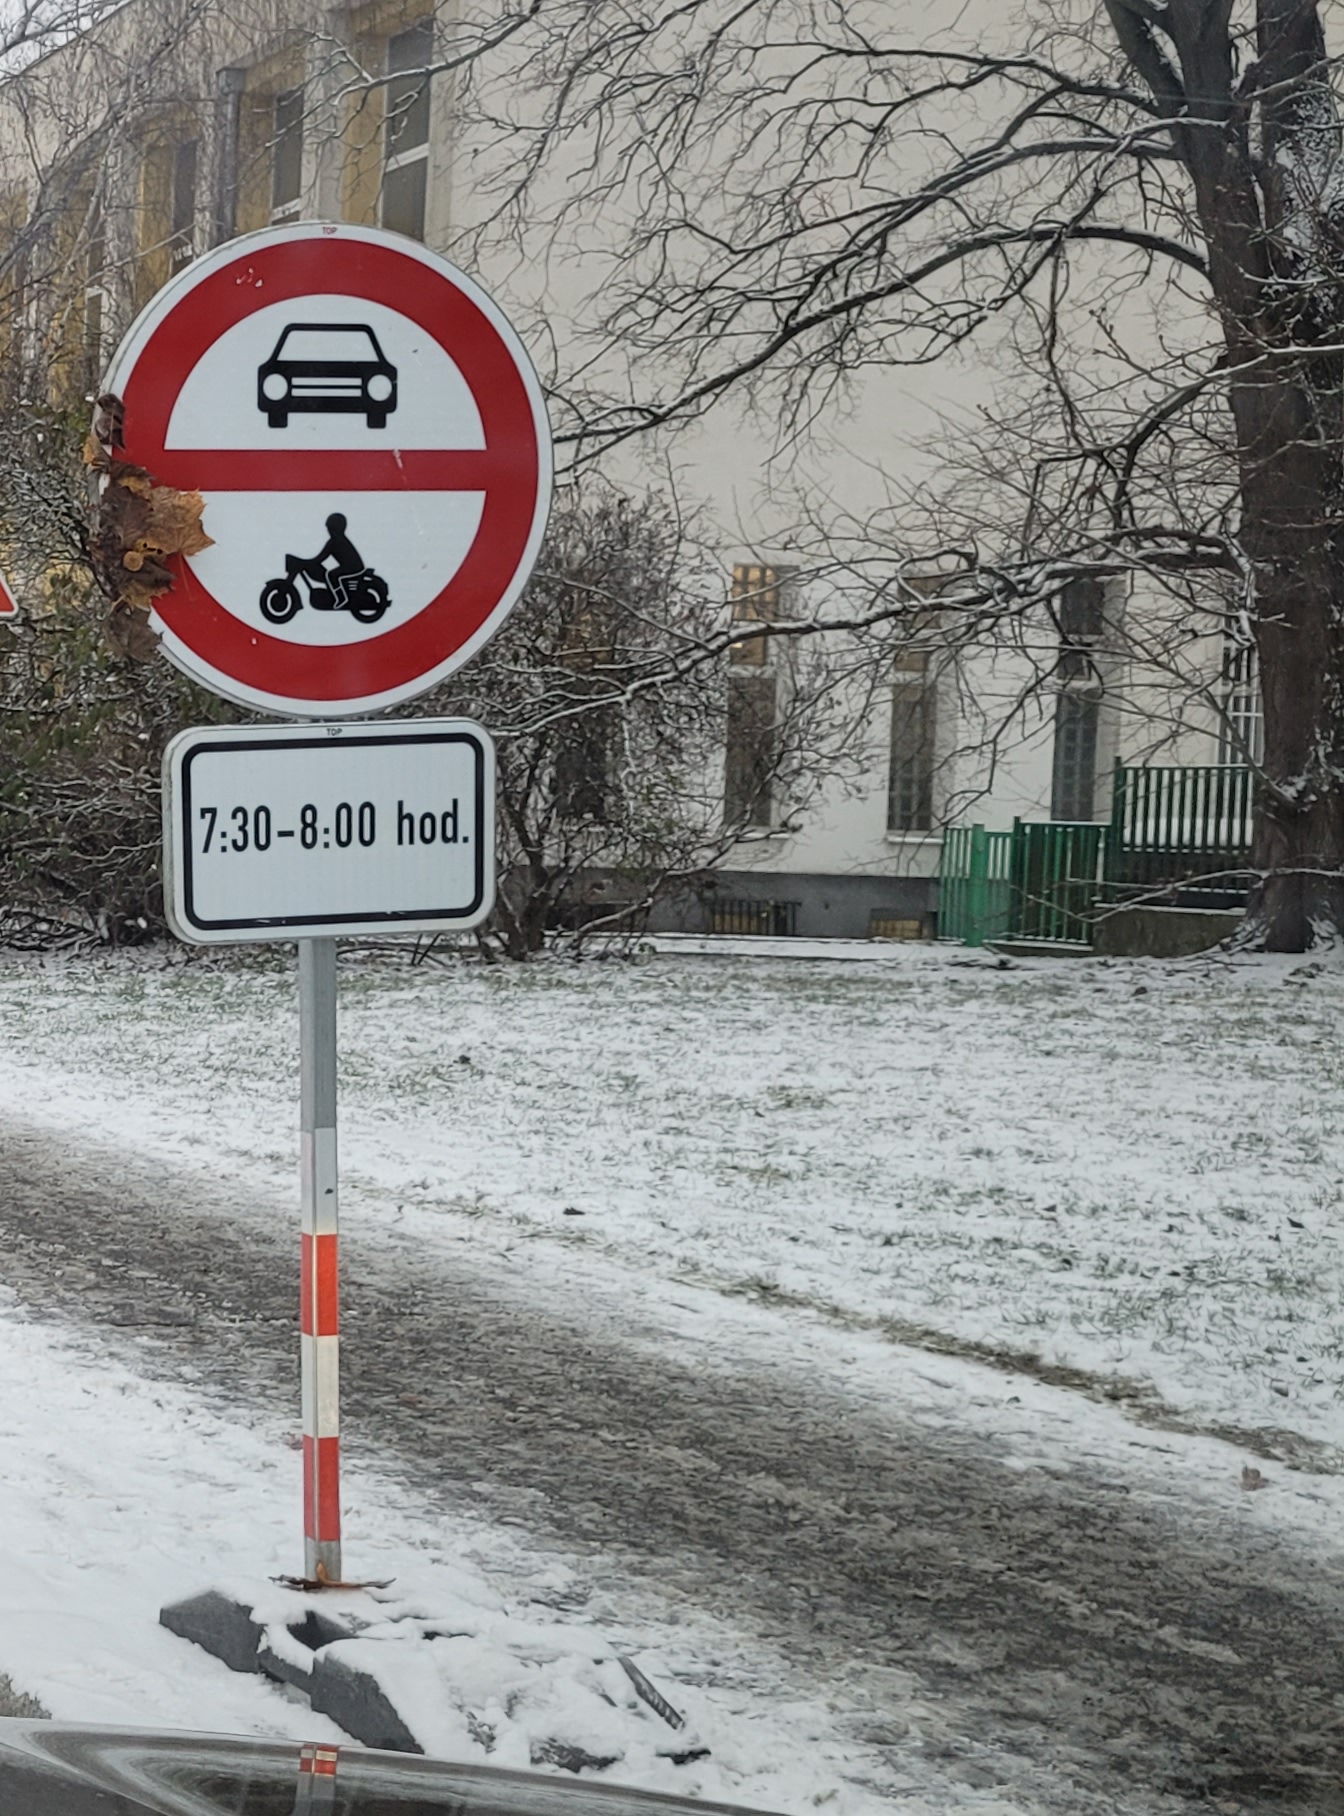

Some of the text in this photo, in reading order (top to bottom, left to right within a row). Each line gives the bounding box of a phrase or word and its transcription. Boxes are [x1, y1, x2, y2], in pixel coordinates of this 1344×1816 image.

[322, 226, 338, 235] TOP
[326, 727, 343, 736] TOP
[200, 798, 469, 853] 7:30-8:00 hod.
